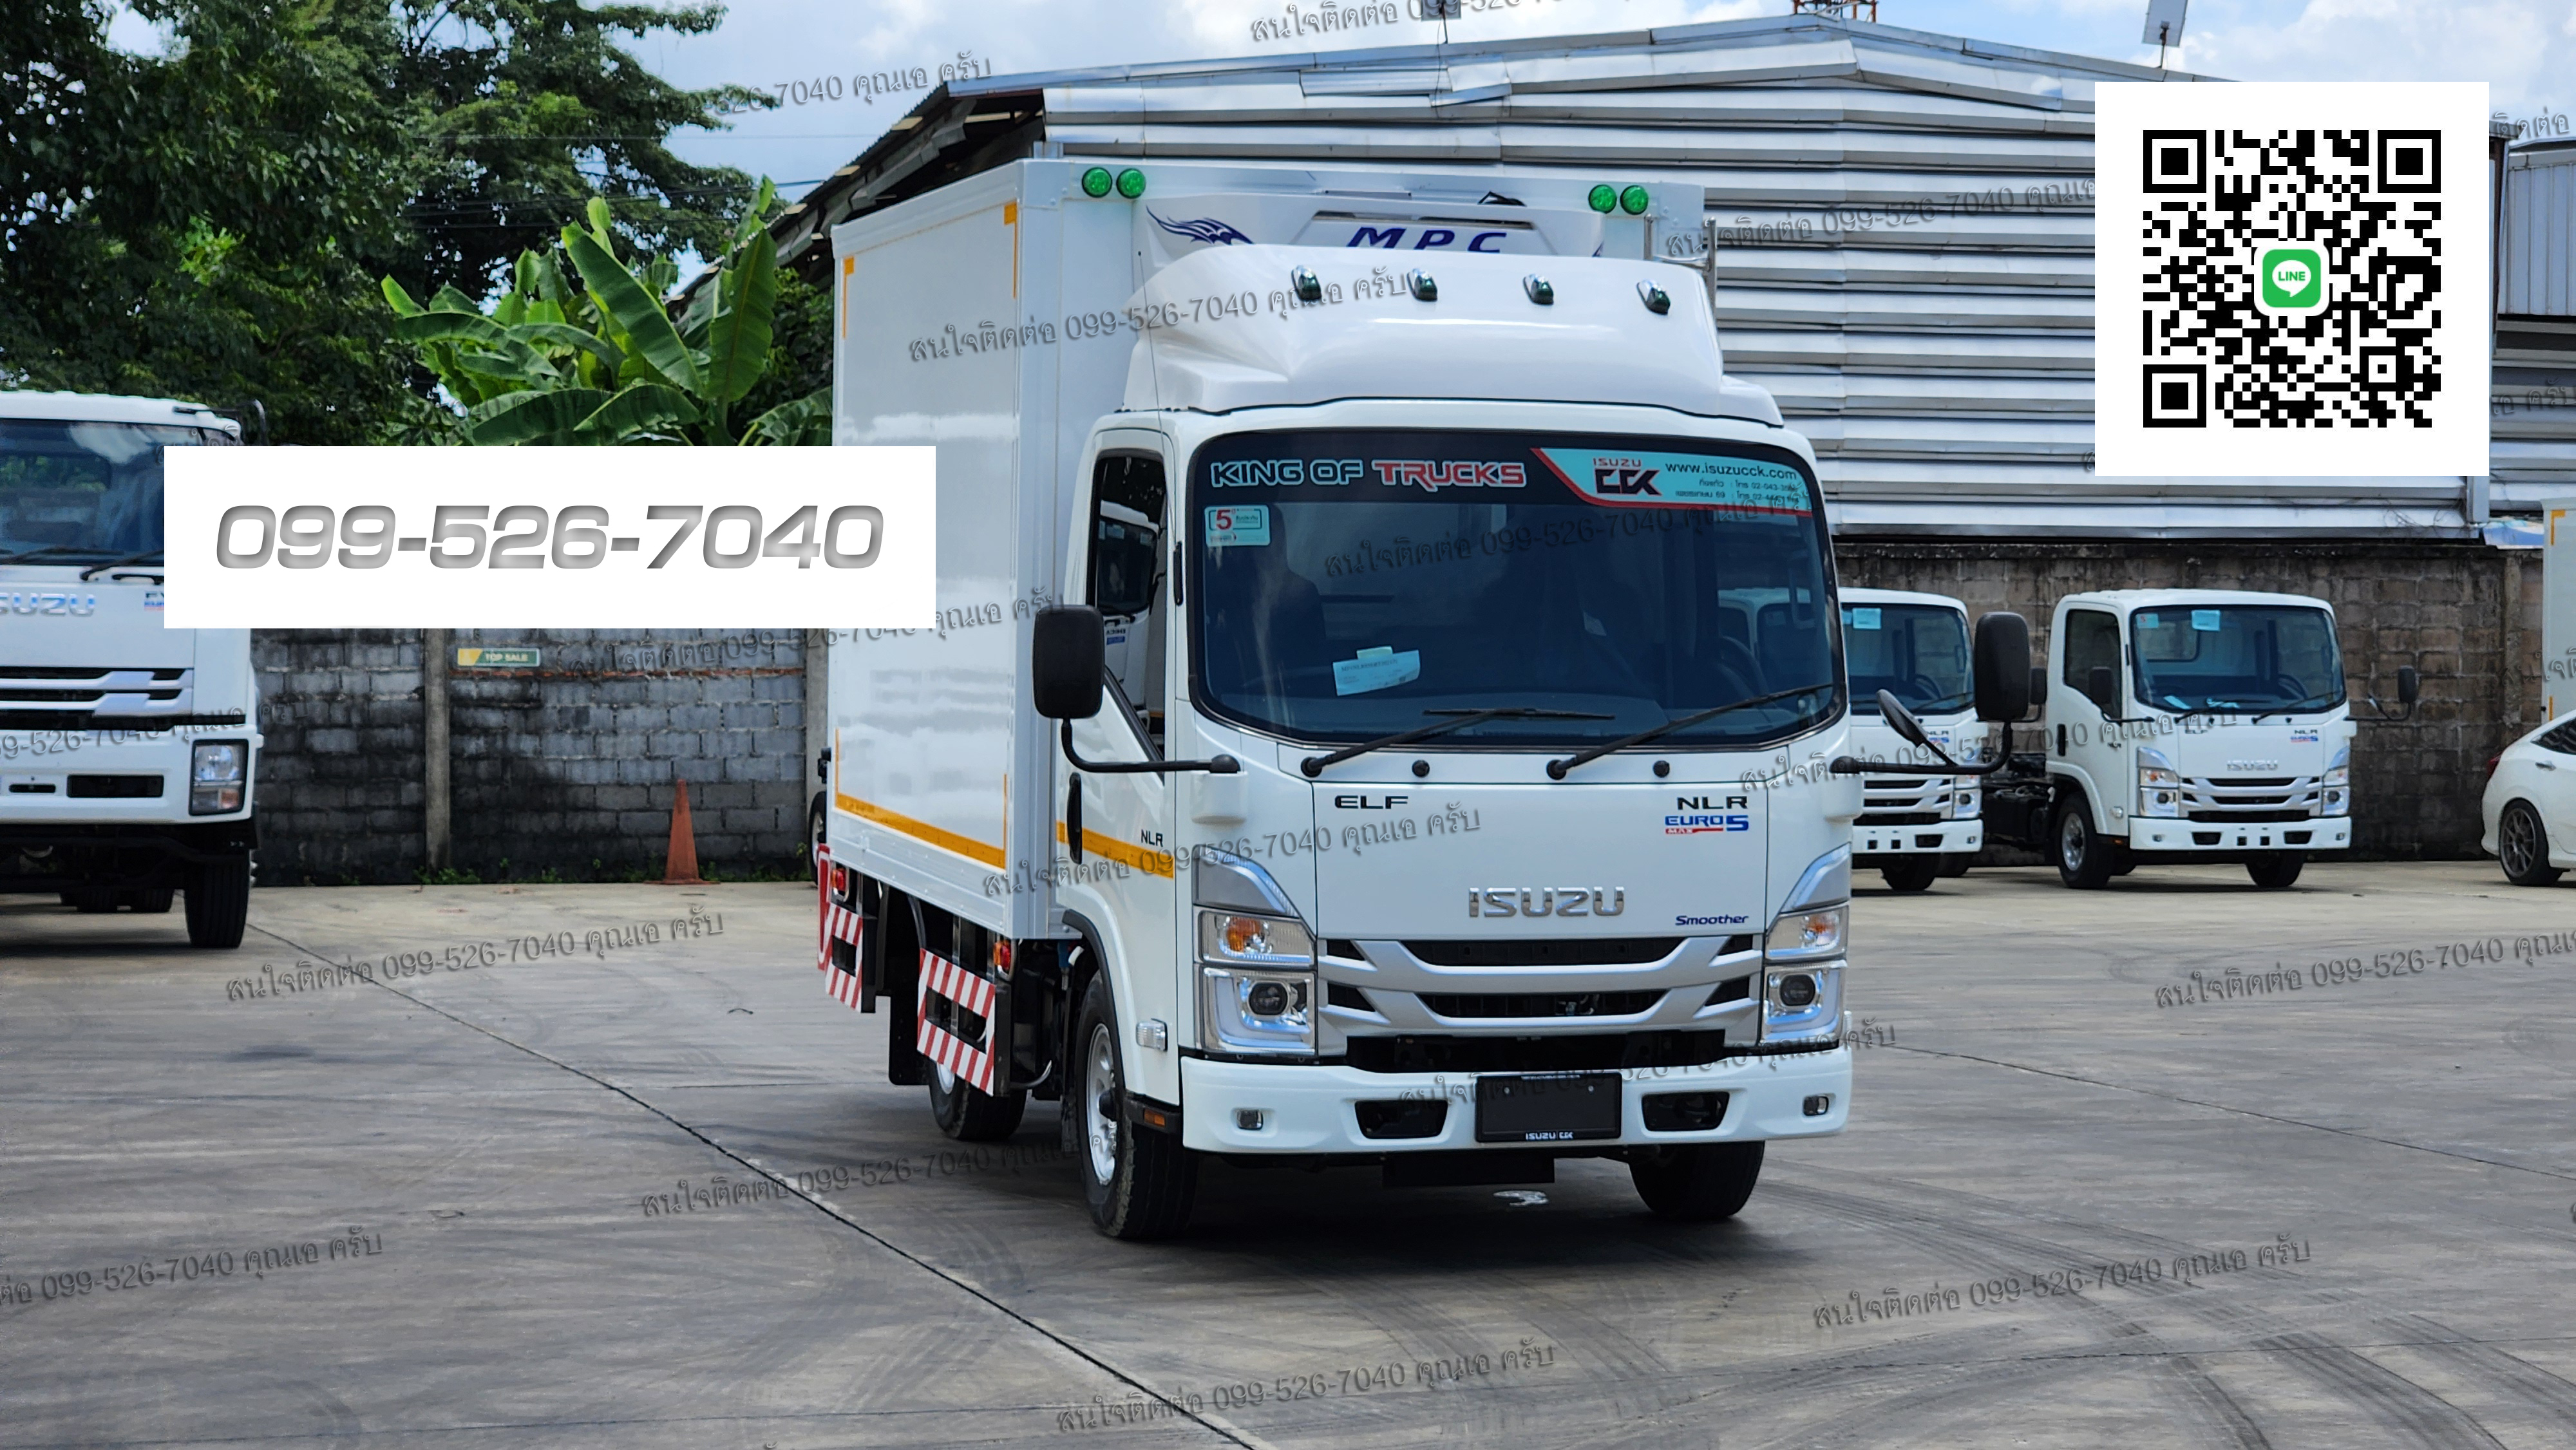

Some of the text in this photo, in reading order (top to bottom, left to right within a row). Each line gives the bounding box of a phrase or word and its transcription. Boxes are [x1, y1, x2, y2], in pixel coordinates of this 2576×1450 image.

[1347, 227, 1506, 253] MPC
[1593, 458, 1642, 467] ISUZU
[1665, 462, 1797, 480] www.isuzucck.com
[1210, 459, 1526, 491] KING OF TRUCKS
[1217, 509, 1231, 530] 5
[0, 593, 95, 616] UZU
[486, 653, 529, 661] TOP SALE
[2227, 759, 2278, 771] ISUZU
[1334, 795, 1408, 809] ELF
[1677, 796, 1748, 810] NLR
[1141, 829, 1163, 847] NLR
[1468, 887, 1624, 918] ISUZU
[1676, 914, 1749, 926] Smoother
